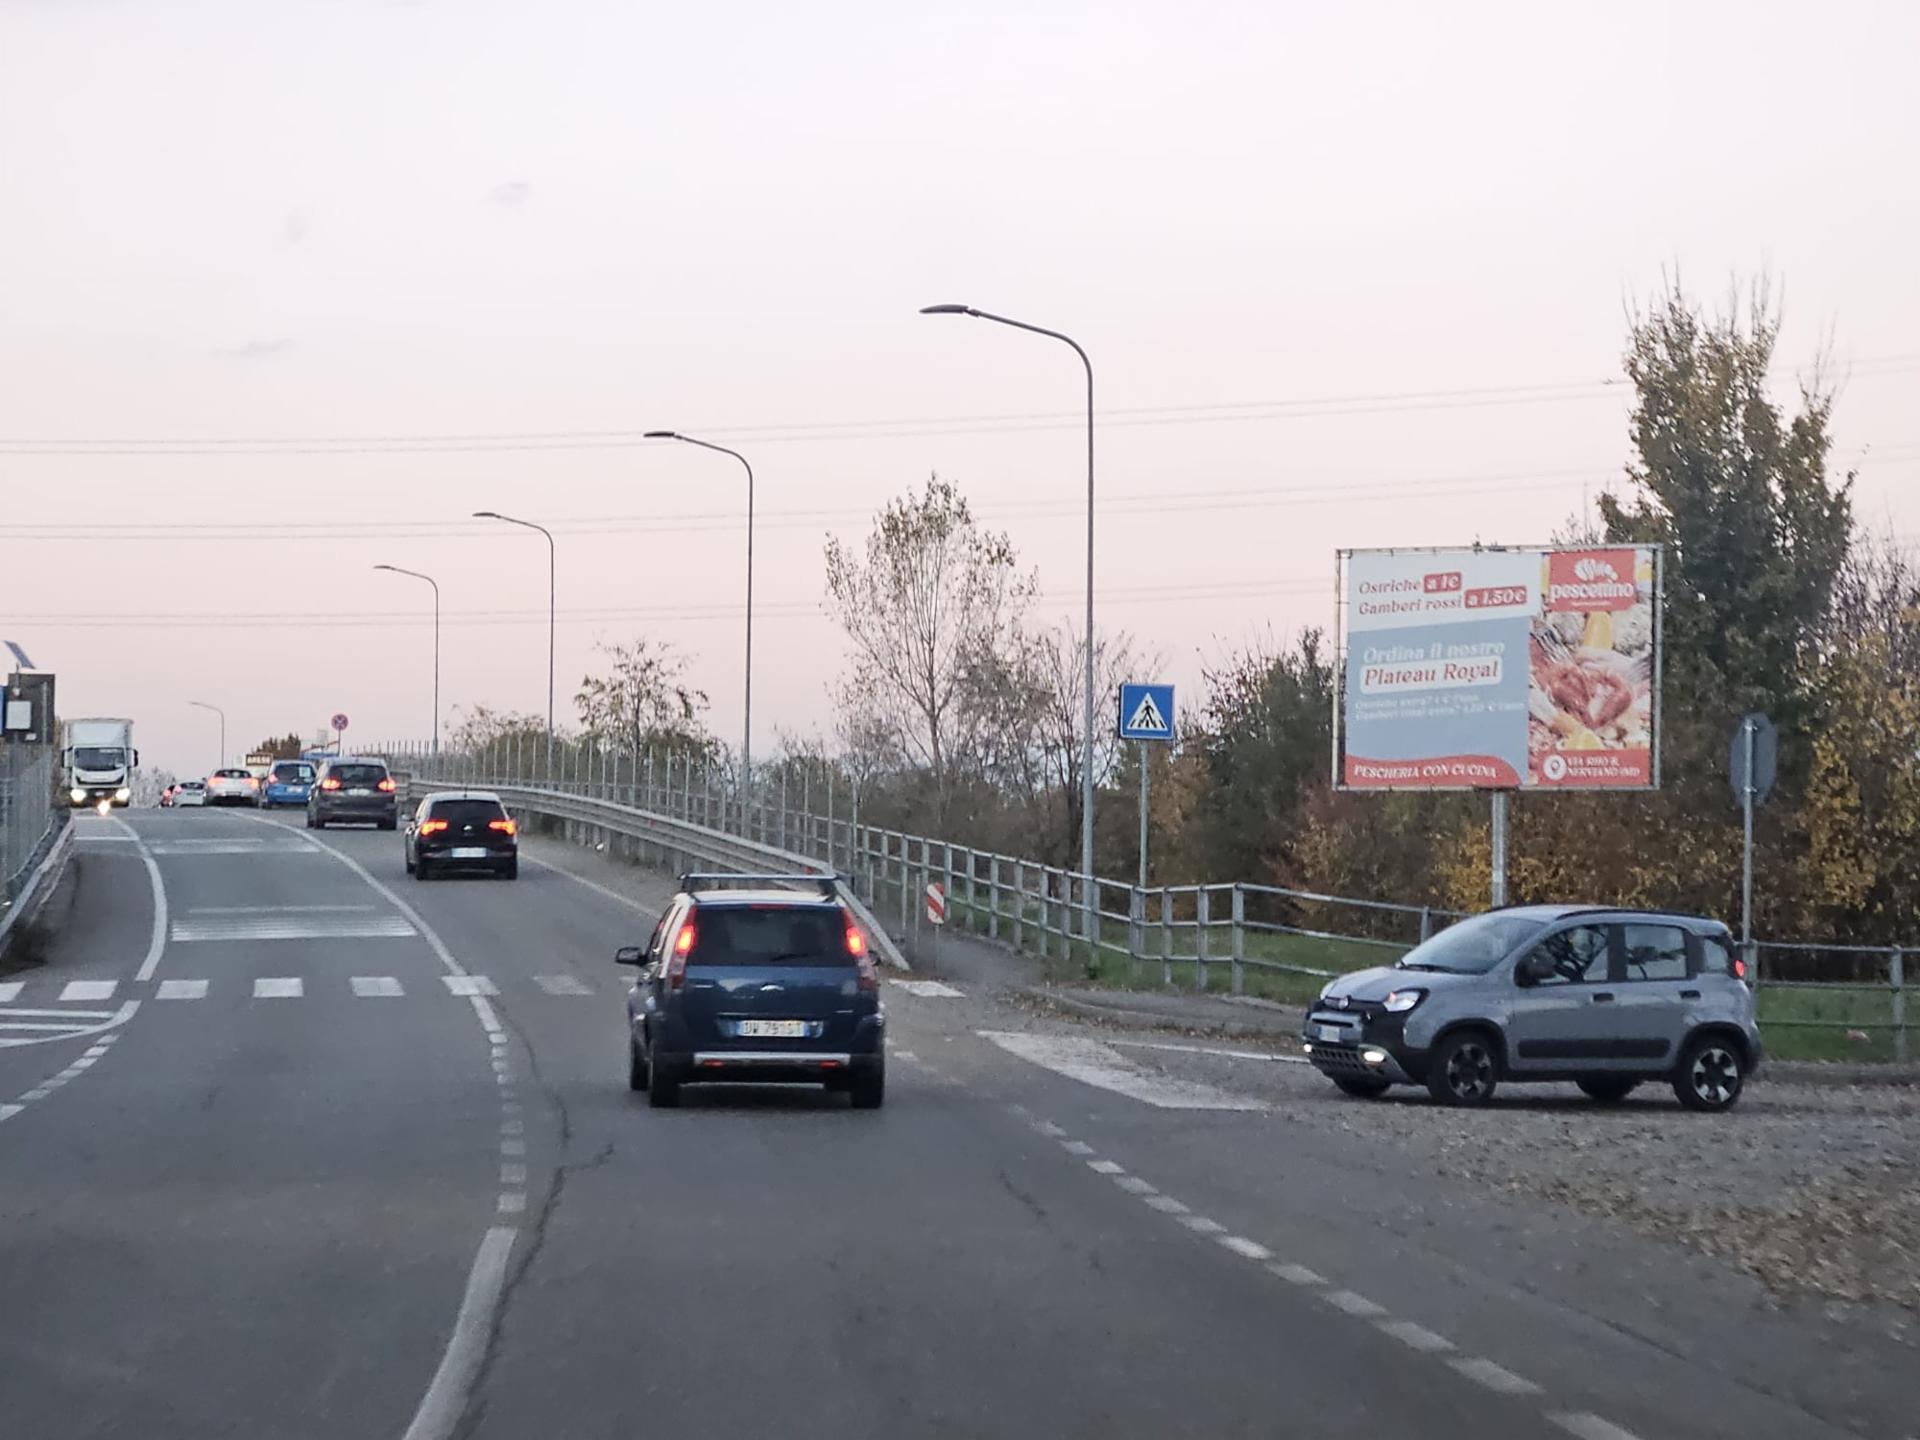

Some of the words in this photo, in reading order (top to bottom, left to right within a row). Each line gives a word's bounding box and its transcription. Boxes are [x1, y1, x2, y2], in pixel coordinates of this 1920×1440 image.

[1359, 579, 1421, 594] Ostriche
[1359, 598, 1421, 615] Gamberi
[1425, 595, 1462, 611] rossi
[1363, 645, 1425, 663] Ordina
[1430, 642, 1443, 659] il
[1447, 642, 1505, 657] nostro
[1364, 668, 1436, 686] Plateau
[1443, 660, 1499, 683] Royal
[1354, 764, 1420, 779] PESCHERIA
[1423, 763, 1449, 777] CON
[1451, 763, 1497, 778] CUCINA
